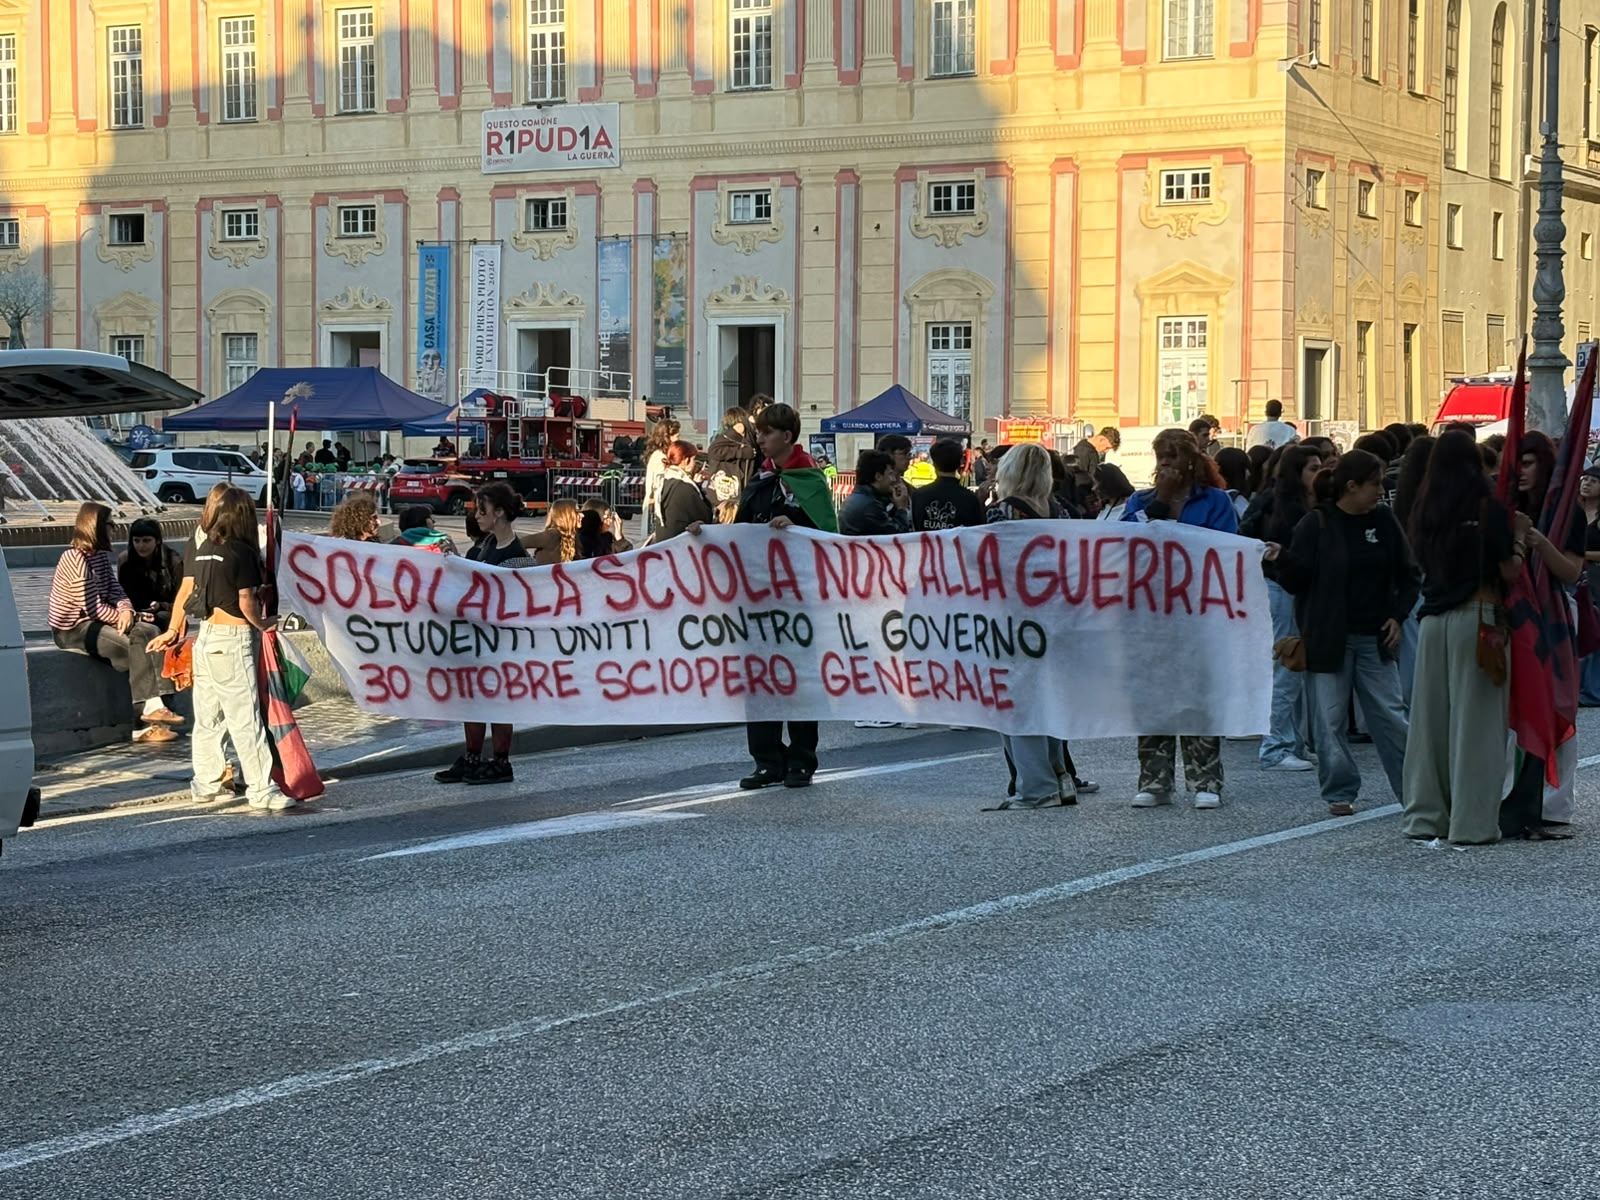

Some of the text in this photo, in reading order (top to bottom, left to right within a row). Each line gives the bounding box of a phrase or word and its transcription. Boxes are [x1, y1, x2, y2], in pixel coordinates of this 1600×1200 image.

[486, 117, 558, 130] QUESTO COMUNE
[486, 125, 613, 156] R1PUD1A
[567, 152, 615, 161] LA GUERRA
[477, 259, 486, 297] PHOTO
[424, 268, 437, 349] CASA LUZZATI
[476, 300, 485, 332] PRESS
[485, 289, 495, 363] EXHIBITION
[475, 335, 485, 374] WORLD
[598, 331, 611, 360] THE
[599, 362, 610, 380] AT
[286, 532, 1248, 621] SOLDI ALLA SCUOLA NON ALLA GUERRA!
[346, 605, 1048, 660] STUDENTI UNITI CONTRO IL GOVERNO
[357, 650, 1015, 712] 30 OTTOBRE SCIOPERO GENERALE
